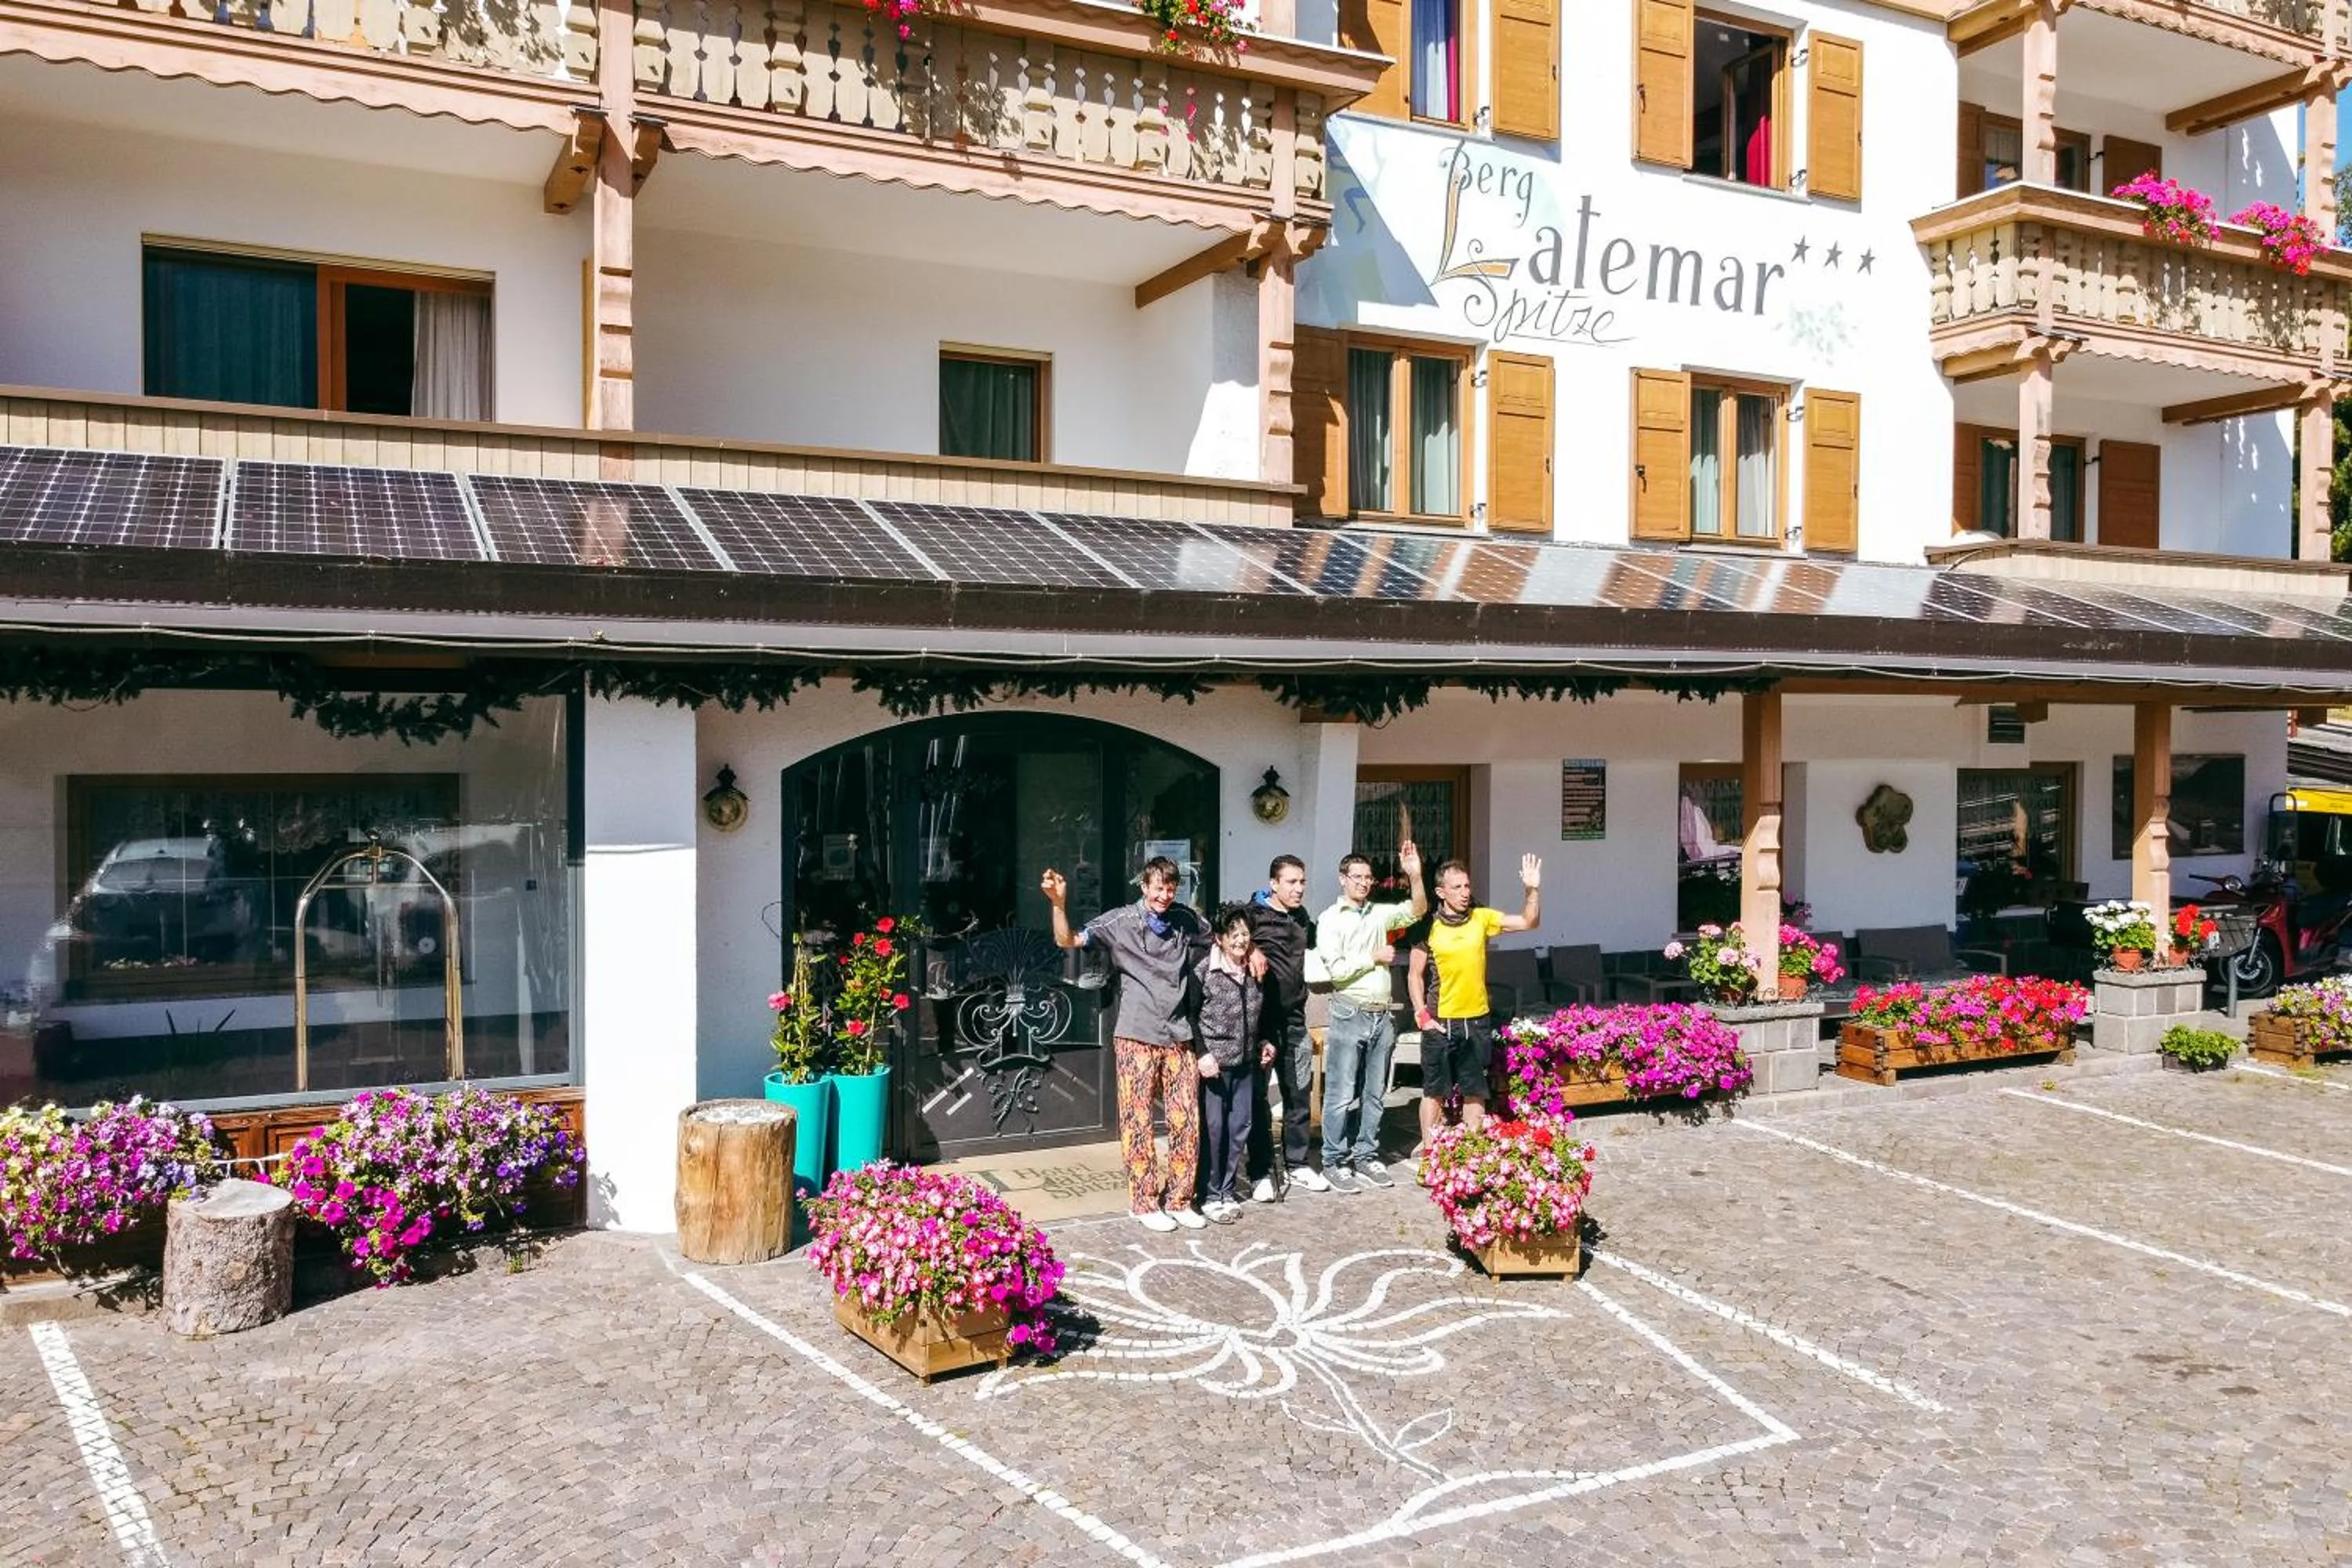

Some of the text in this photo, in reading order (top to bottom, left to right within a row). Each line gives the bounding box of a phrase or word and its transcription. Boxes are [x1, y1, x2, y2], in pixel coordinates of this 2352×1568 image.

[1430, 140, 1785, 315] Latemar
[1439, 140, 1534, 228] Berg
[1465, 238, 1637, 343] Spitze
[1014, 1162, 1094, 1180] Hotel
